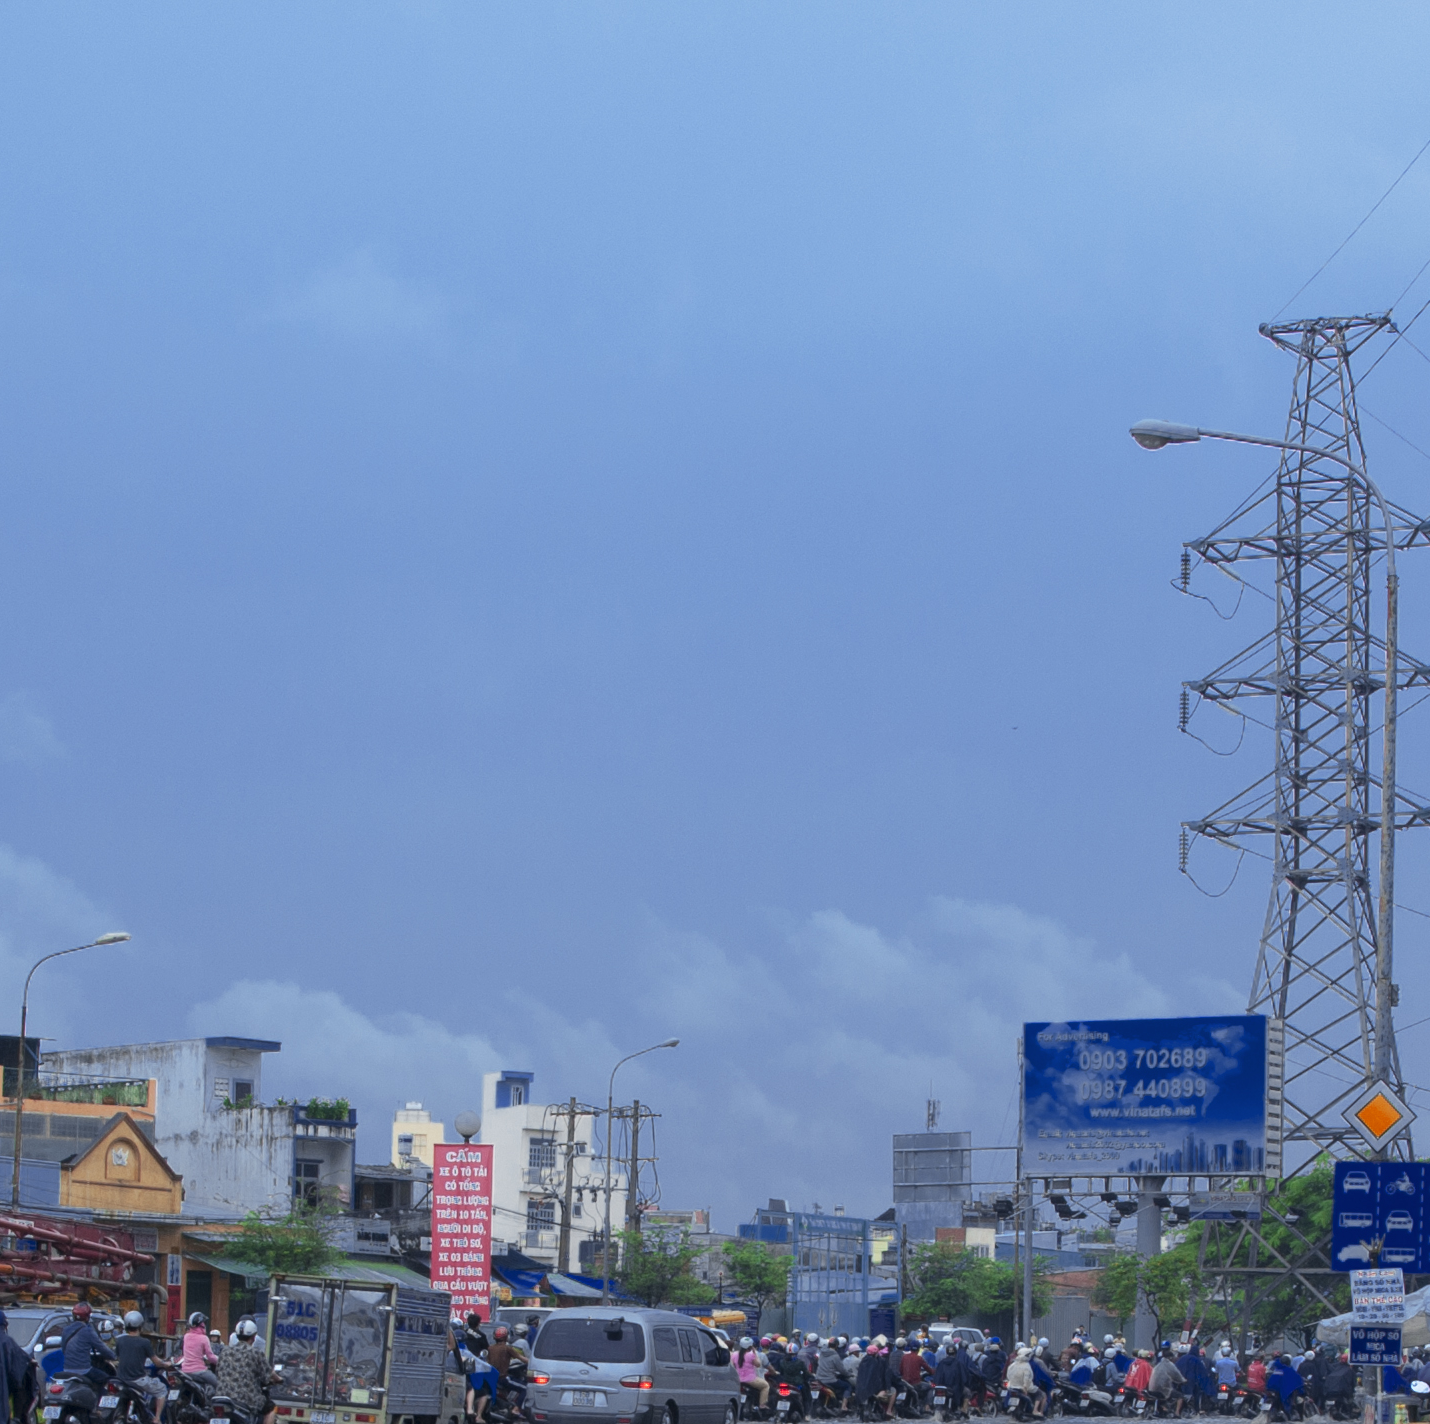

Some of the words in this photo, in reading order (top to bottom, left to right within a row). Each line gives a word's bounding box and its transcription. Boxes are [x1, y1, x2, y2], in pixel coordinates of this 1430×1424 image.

[1037, 1032, 1054, 1041] For
[1056, 1031, 1109, 1042] Advertising
[1079, 1050, 1127, 1071] 0903
[1134, 1048, 1208, 1069] 702689
[1081, 1080, 1127, 1100] 0987
[1133, 1078, 1207, 1099] 440899
[1090, 1104, 1197, 1118] www.vinatafs.net
[445, 1149, 481, 1163] CẤM
[439, 1167, 450, 1177] XE
[452, 1166, 458, 1177] Ô
[460, 1166, 471, 1177] TÔ
[474, 1166, 487, 1177] TẢI
[445, 1180, 457, 1190] CÓ
[436, 1208, 457, 1219] TRÊN
[459, 1210, 468, 1219] 10
[440, 1238, 450, 1247] XE
[439, 1253, 449, 1262] XE
[450, 1253, 461, 1262] 03
[286, 1300, 316, 1318] 51C
[276, 1323, 318, 1341] 08805
